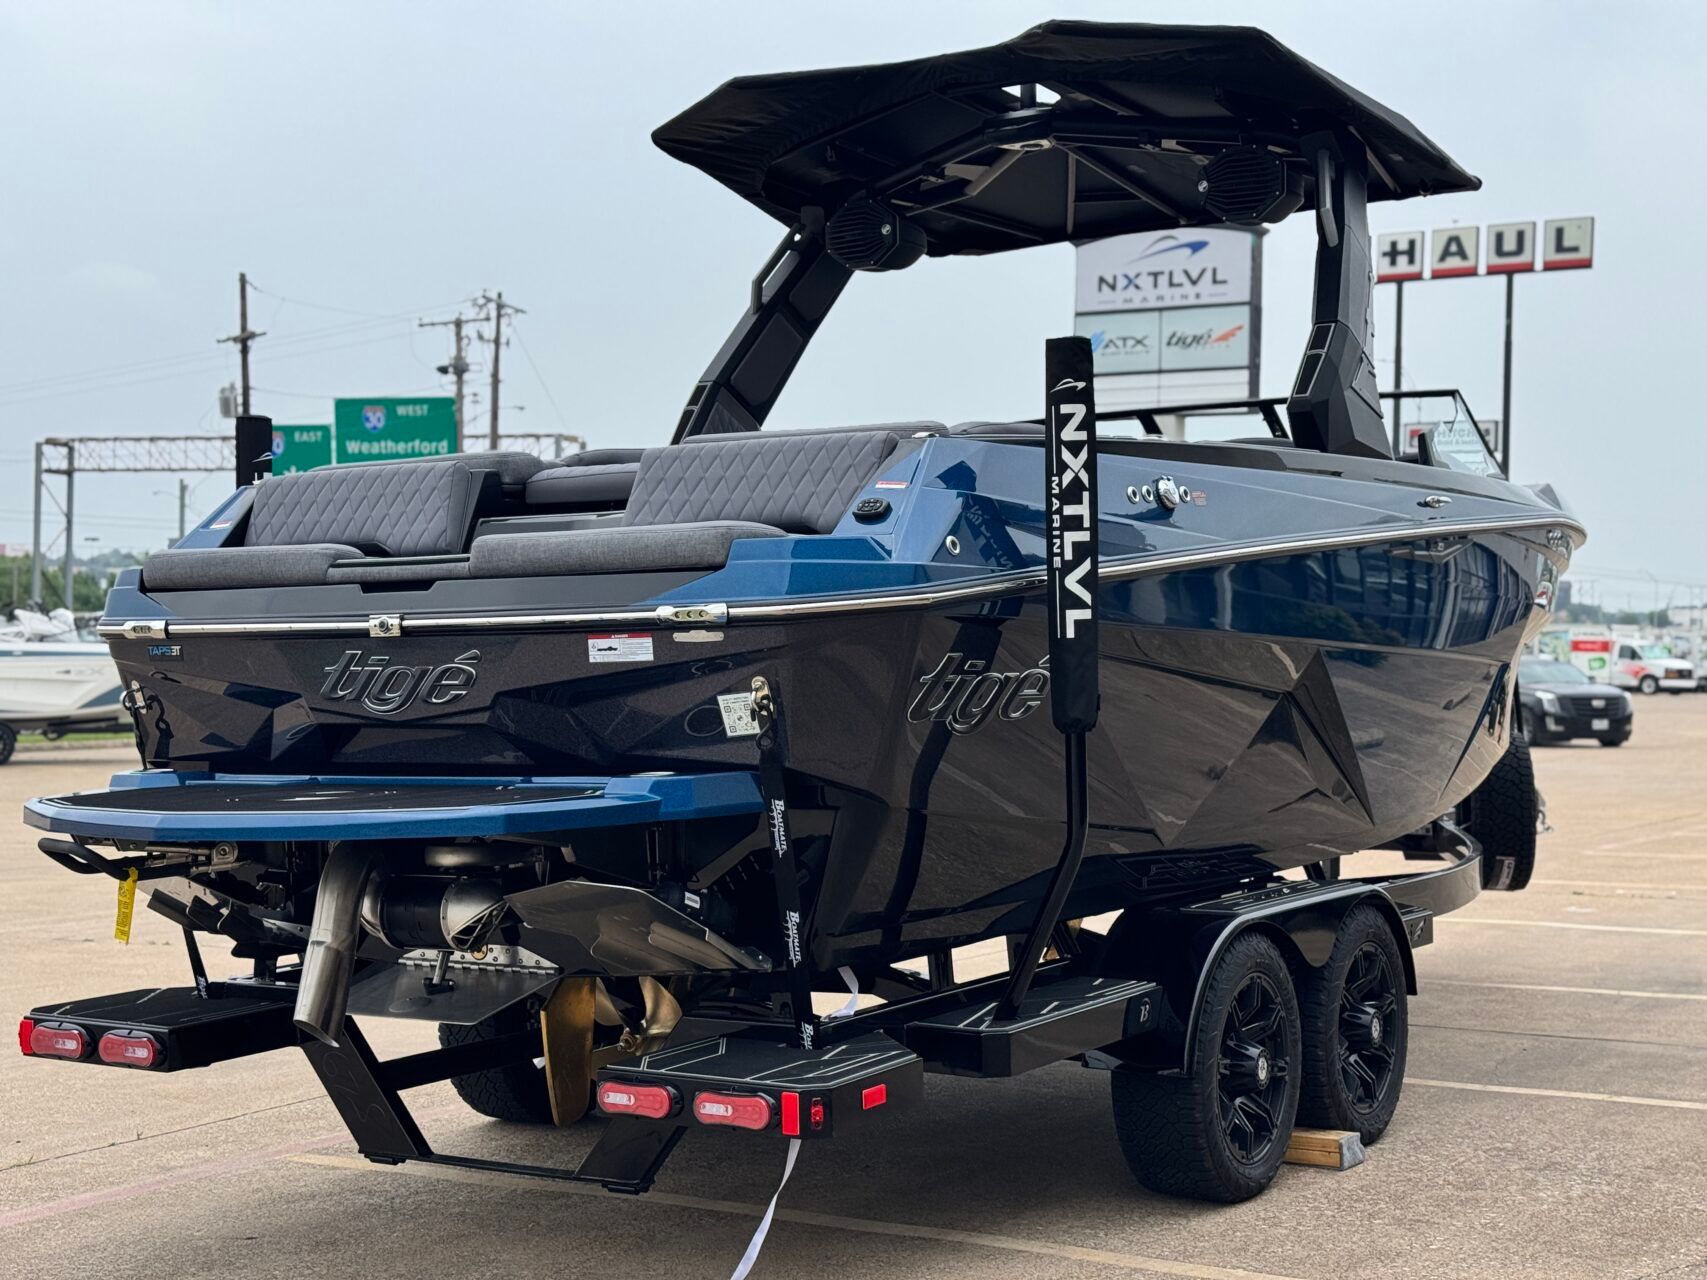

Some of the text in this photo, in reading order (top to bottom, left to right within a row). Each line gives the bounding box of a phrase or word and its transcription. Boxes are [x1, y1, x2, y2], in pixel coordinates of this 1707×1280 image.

[1097, 266, 1228, 293] NXTLVL
[1123, 292, 1203, 304] MARINE
[1103, 335, 1149, 350] ATX
[363, 404, 429, 426] 30 WEST
[294, 430, 322, 442] EAST
[346, 439, 449, 455] Weatherford
[1051, 476, 1062, 569] MARINE
[1060, 403, 1092, 639] NXTLVL
[319, 649, 482, 715] tigé
[907, 652, 1051, 736] tigé
